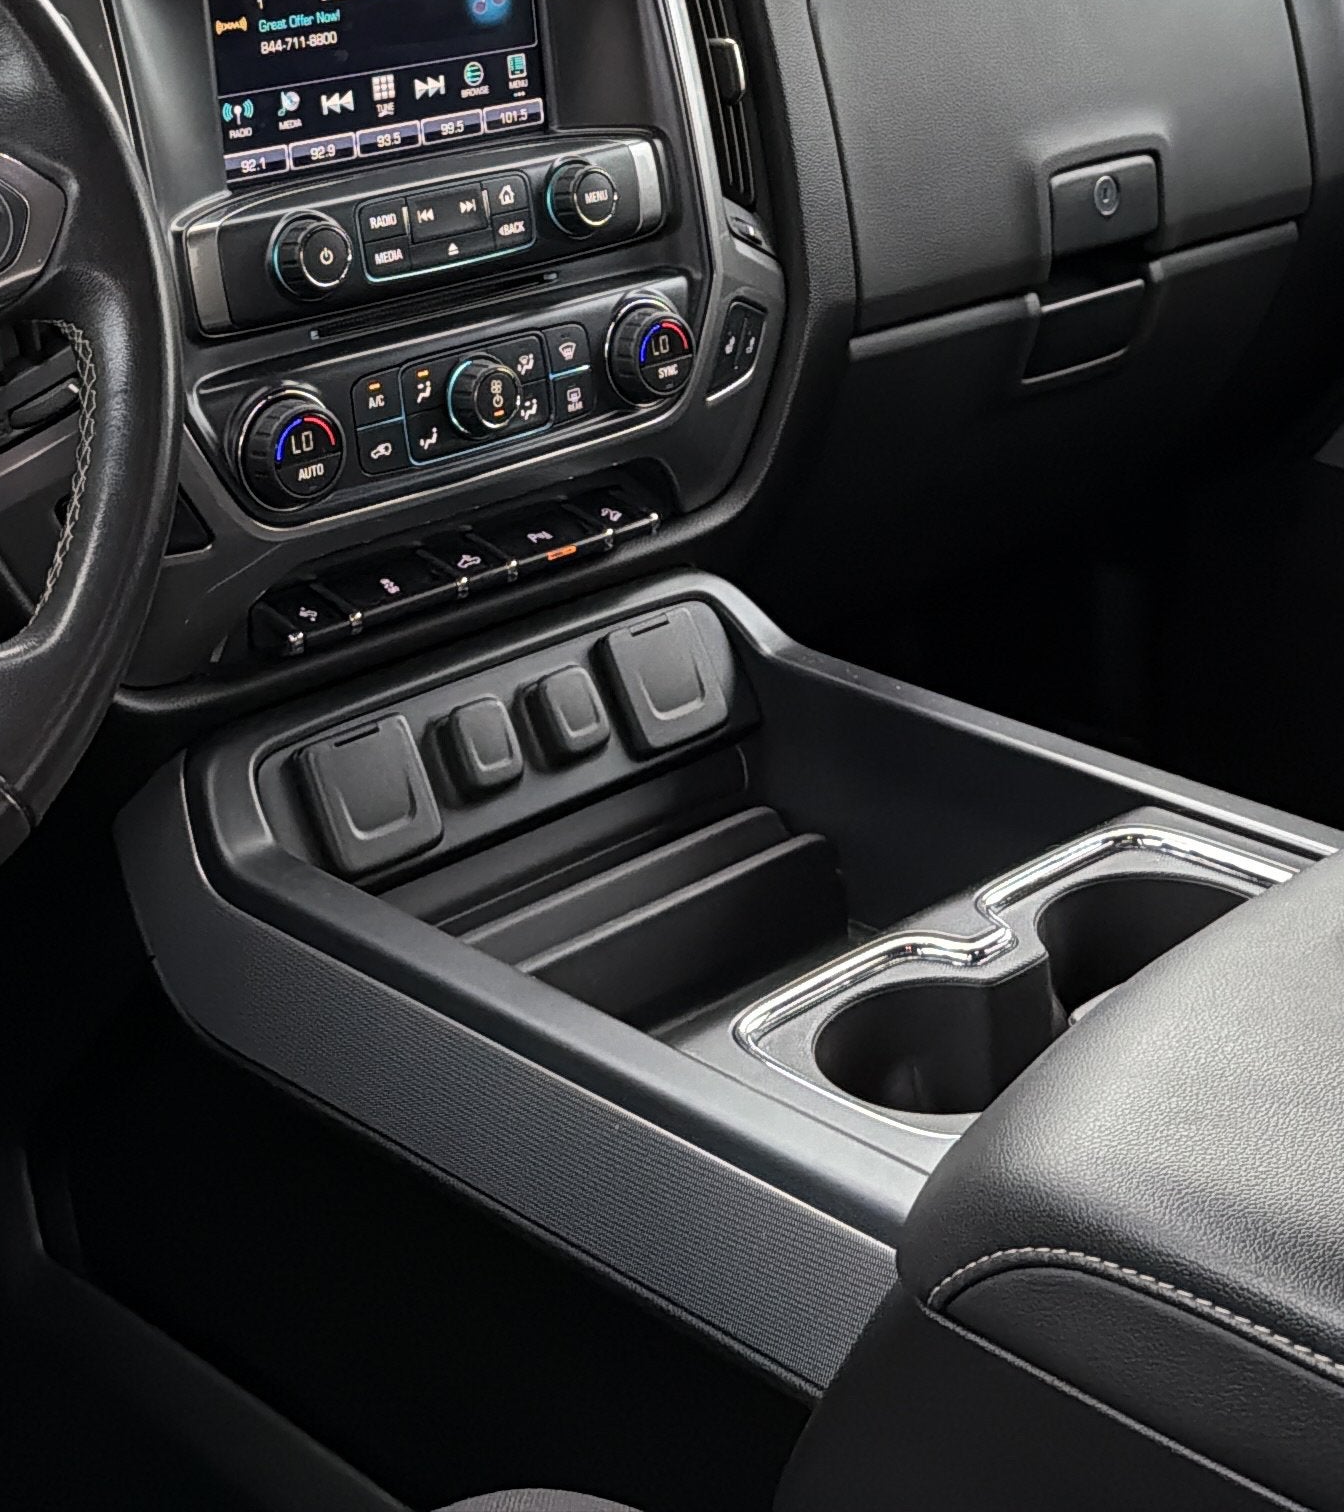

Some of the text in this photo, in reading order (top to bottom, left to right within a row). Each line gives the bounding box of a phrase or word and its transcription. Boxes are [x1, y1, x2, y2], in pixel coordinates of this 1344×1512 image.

[258, 9, 341, 33] Great Offer Now!
[260, 31, 338, 55] 844-711-8800
[508, 77, 529, 89] MENU
[460, 85, 490, 99] BROWSE
[278, 118, 303, 131] MEDIA
[499, 108, 529, 125] 101.5
[228, 126, 253, 140] RADIO
[440, 119, 465, 136] 99.5
[376, 132, 402, 148] 93.5
[310, 144, 336, 160] 92.9
[240, 156, 267, 173] 92.1
[583, 188, 609, 205] MENU
[369, 212, 397, 229] RADIO
[374, 248, 404, 266] MEDIA
[657, 364, 679, 380] SYNC
[368, 394, 385, 409] A/C
[298, 462, 325, 481] AUTO
